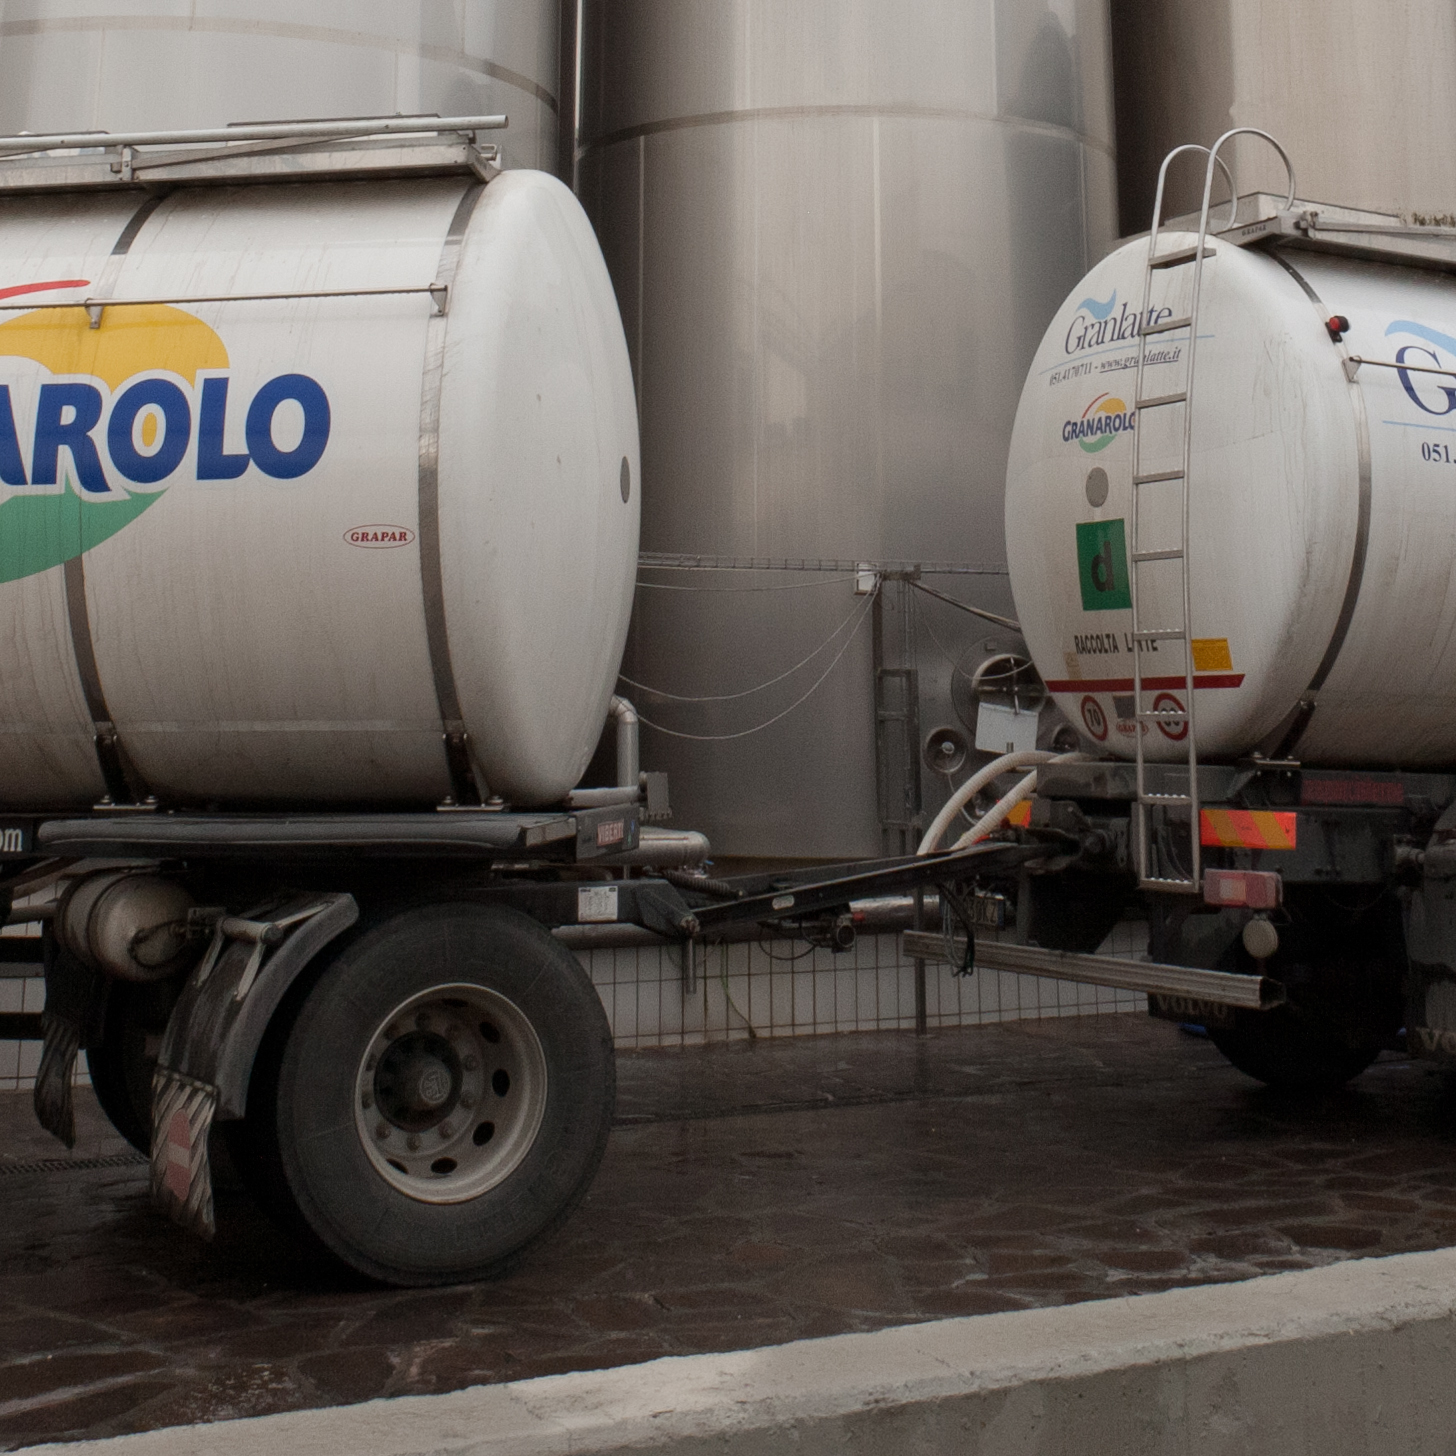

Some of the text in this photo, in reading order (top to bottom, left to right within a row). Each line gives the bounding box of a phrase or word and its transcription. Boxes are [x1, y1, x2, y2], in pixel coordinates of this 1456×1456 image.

[350, 530, 408, 543] GRAPAR
[1091, 540, 1115, 593] d
[1074, 631, 1159, 654] RACCOLTA LTTE
[1087, 707, 1102, 727] 70
